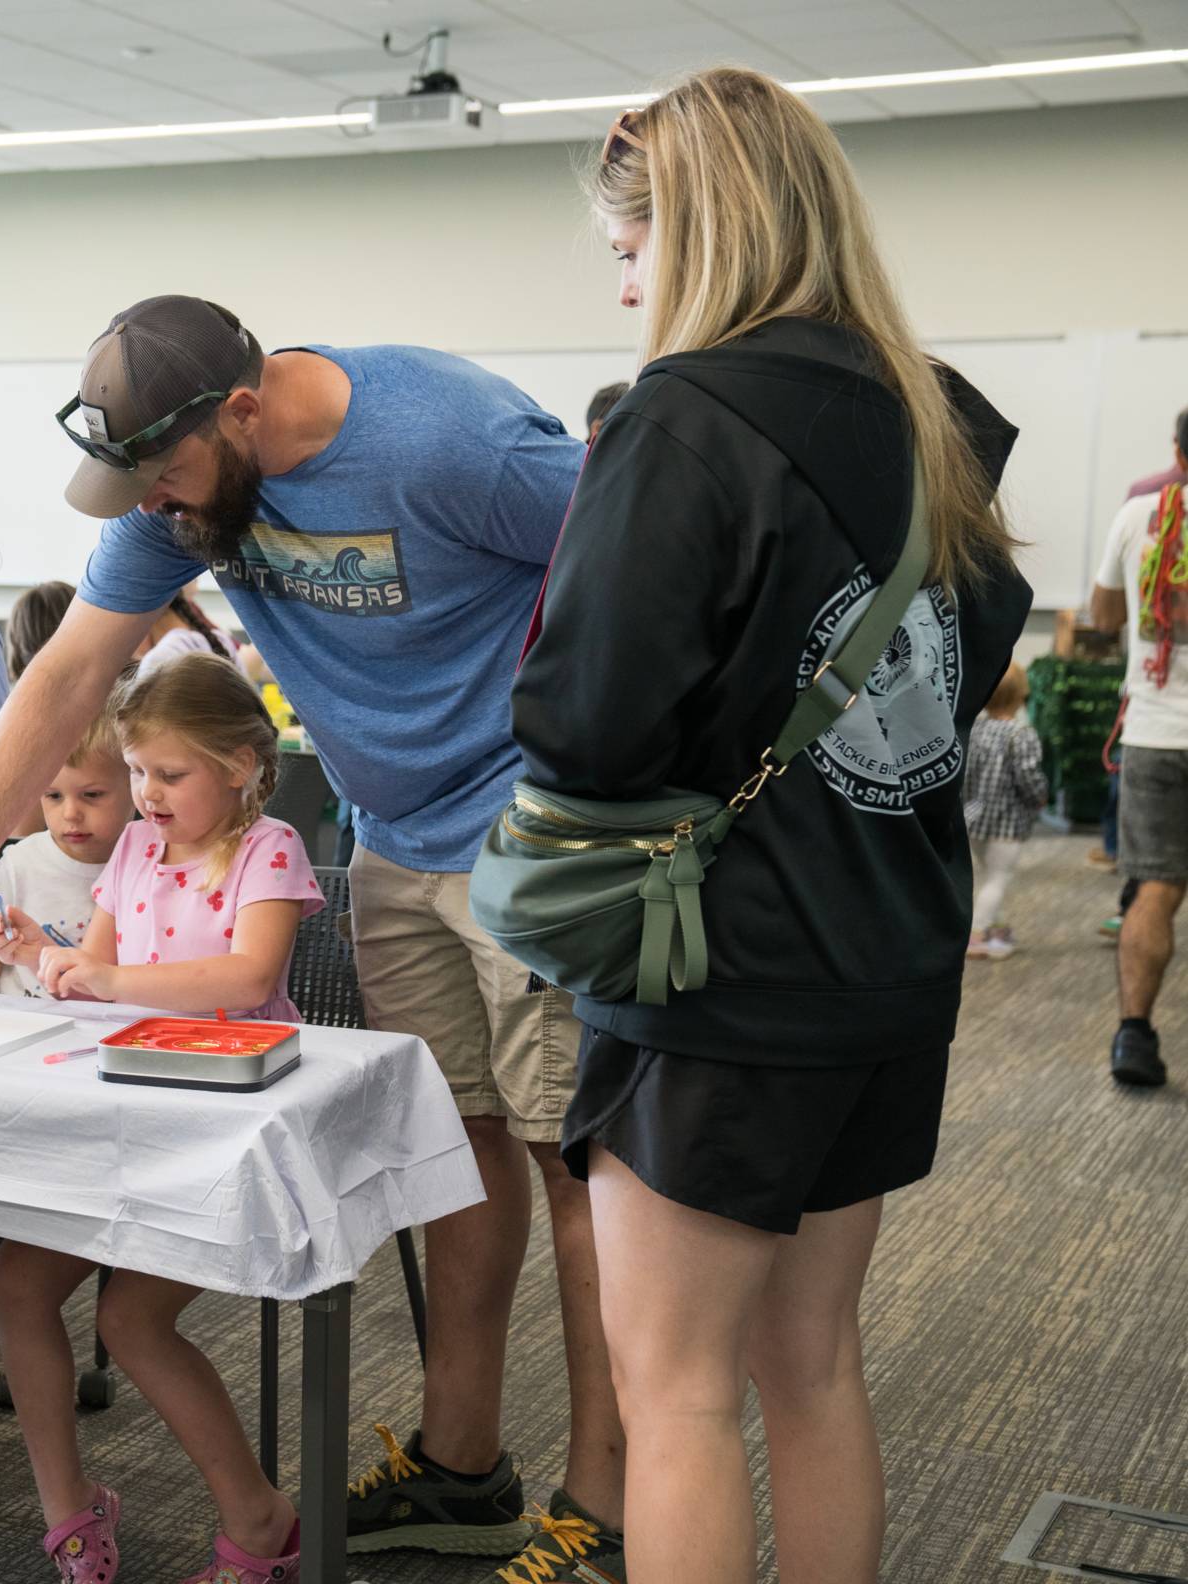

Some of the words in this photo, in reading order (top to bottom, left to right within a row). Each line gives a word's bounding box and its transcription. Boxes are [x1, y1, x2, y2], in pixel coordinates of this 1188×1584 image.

[283, 574, 403, 608] ARANSAS
[929, 584, 957, 704] OLLABORATI
[832, 734, 878, 772] TACKLE
[895, 735, 946, 769] LENGES
[903, 735, 963, 793] NTEGRI
[863, 786, 910, 807] SMT
